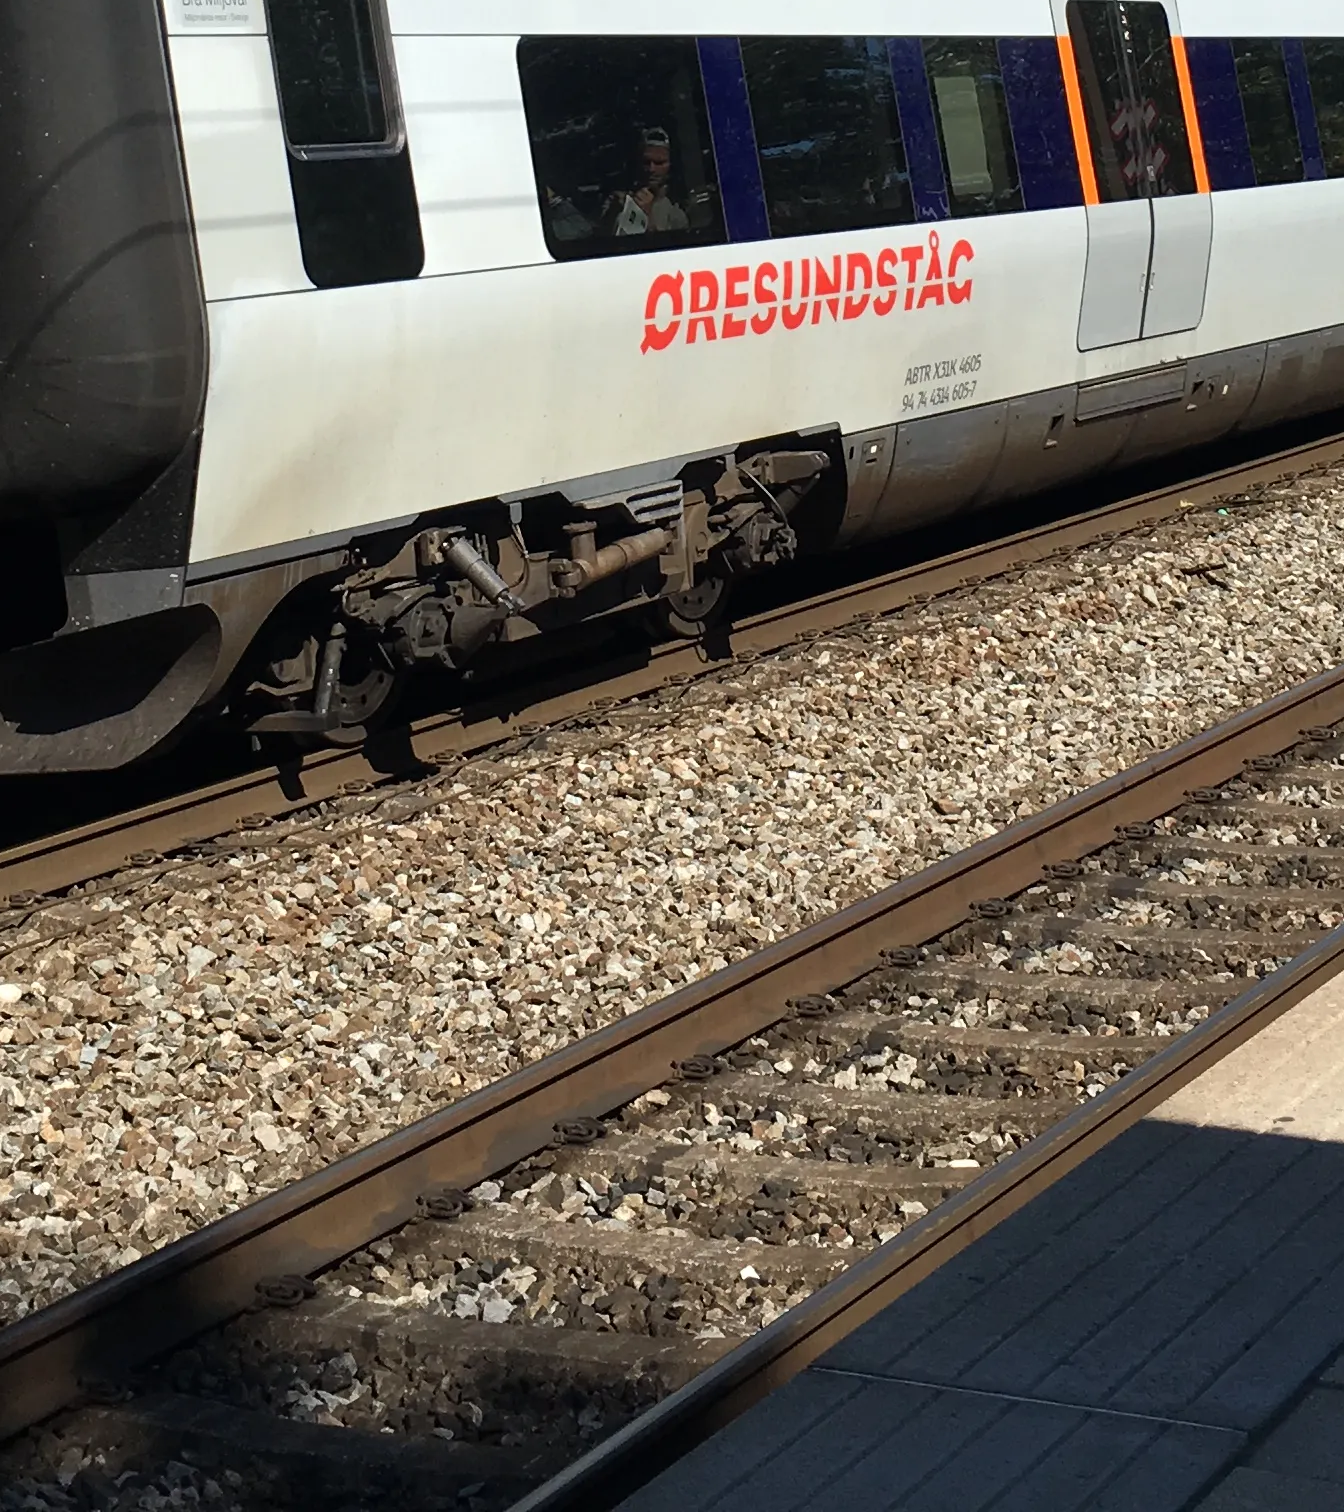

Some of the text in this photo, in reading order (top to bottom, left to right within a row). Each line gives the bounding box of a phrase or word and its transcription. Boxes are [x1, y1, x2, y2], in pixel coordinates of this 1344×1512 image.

[640, 229, 975, 356] ØRESUNDSTÅG
[904, 353, 982, 386] ABTR X31K 4605
[901, 392, 914, 412] 94
[952, 380, 977, 401] 605-7
